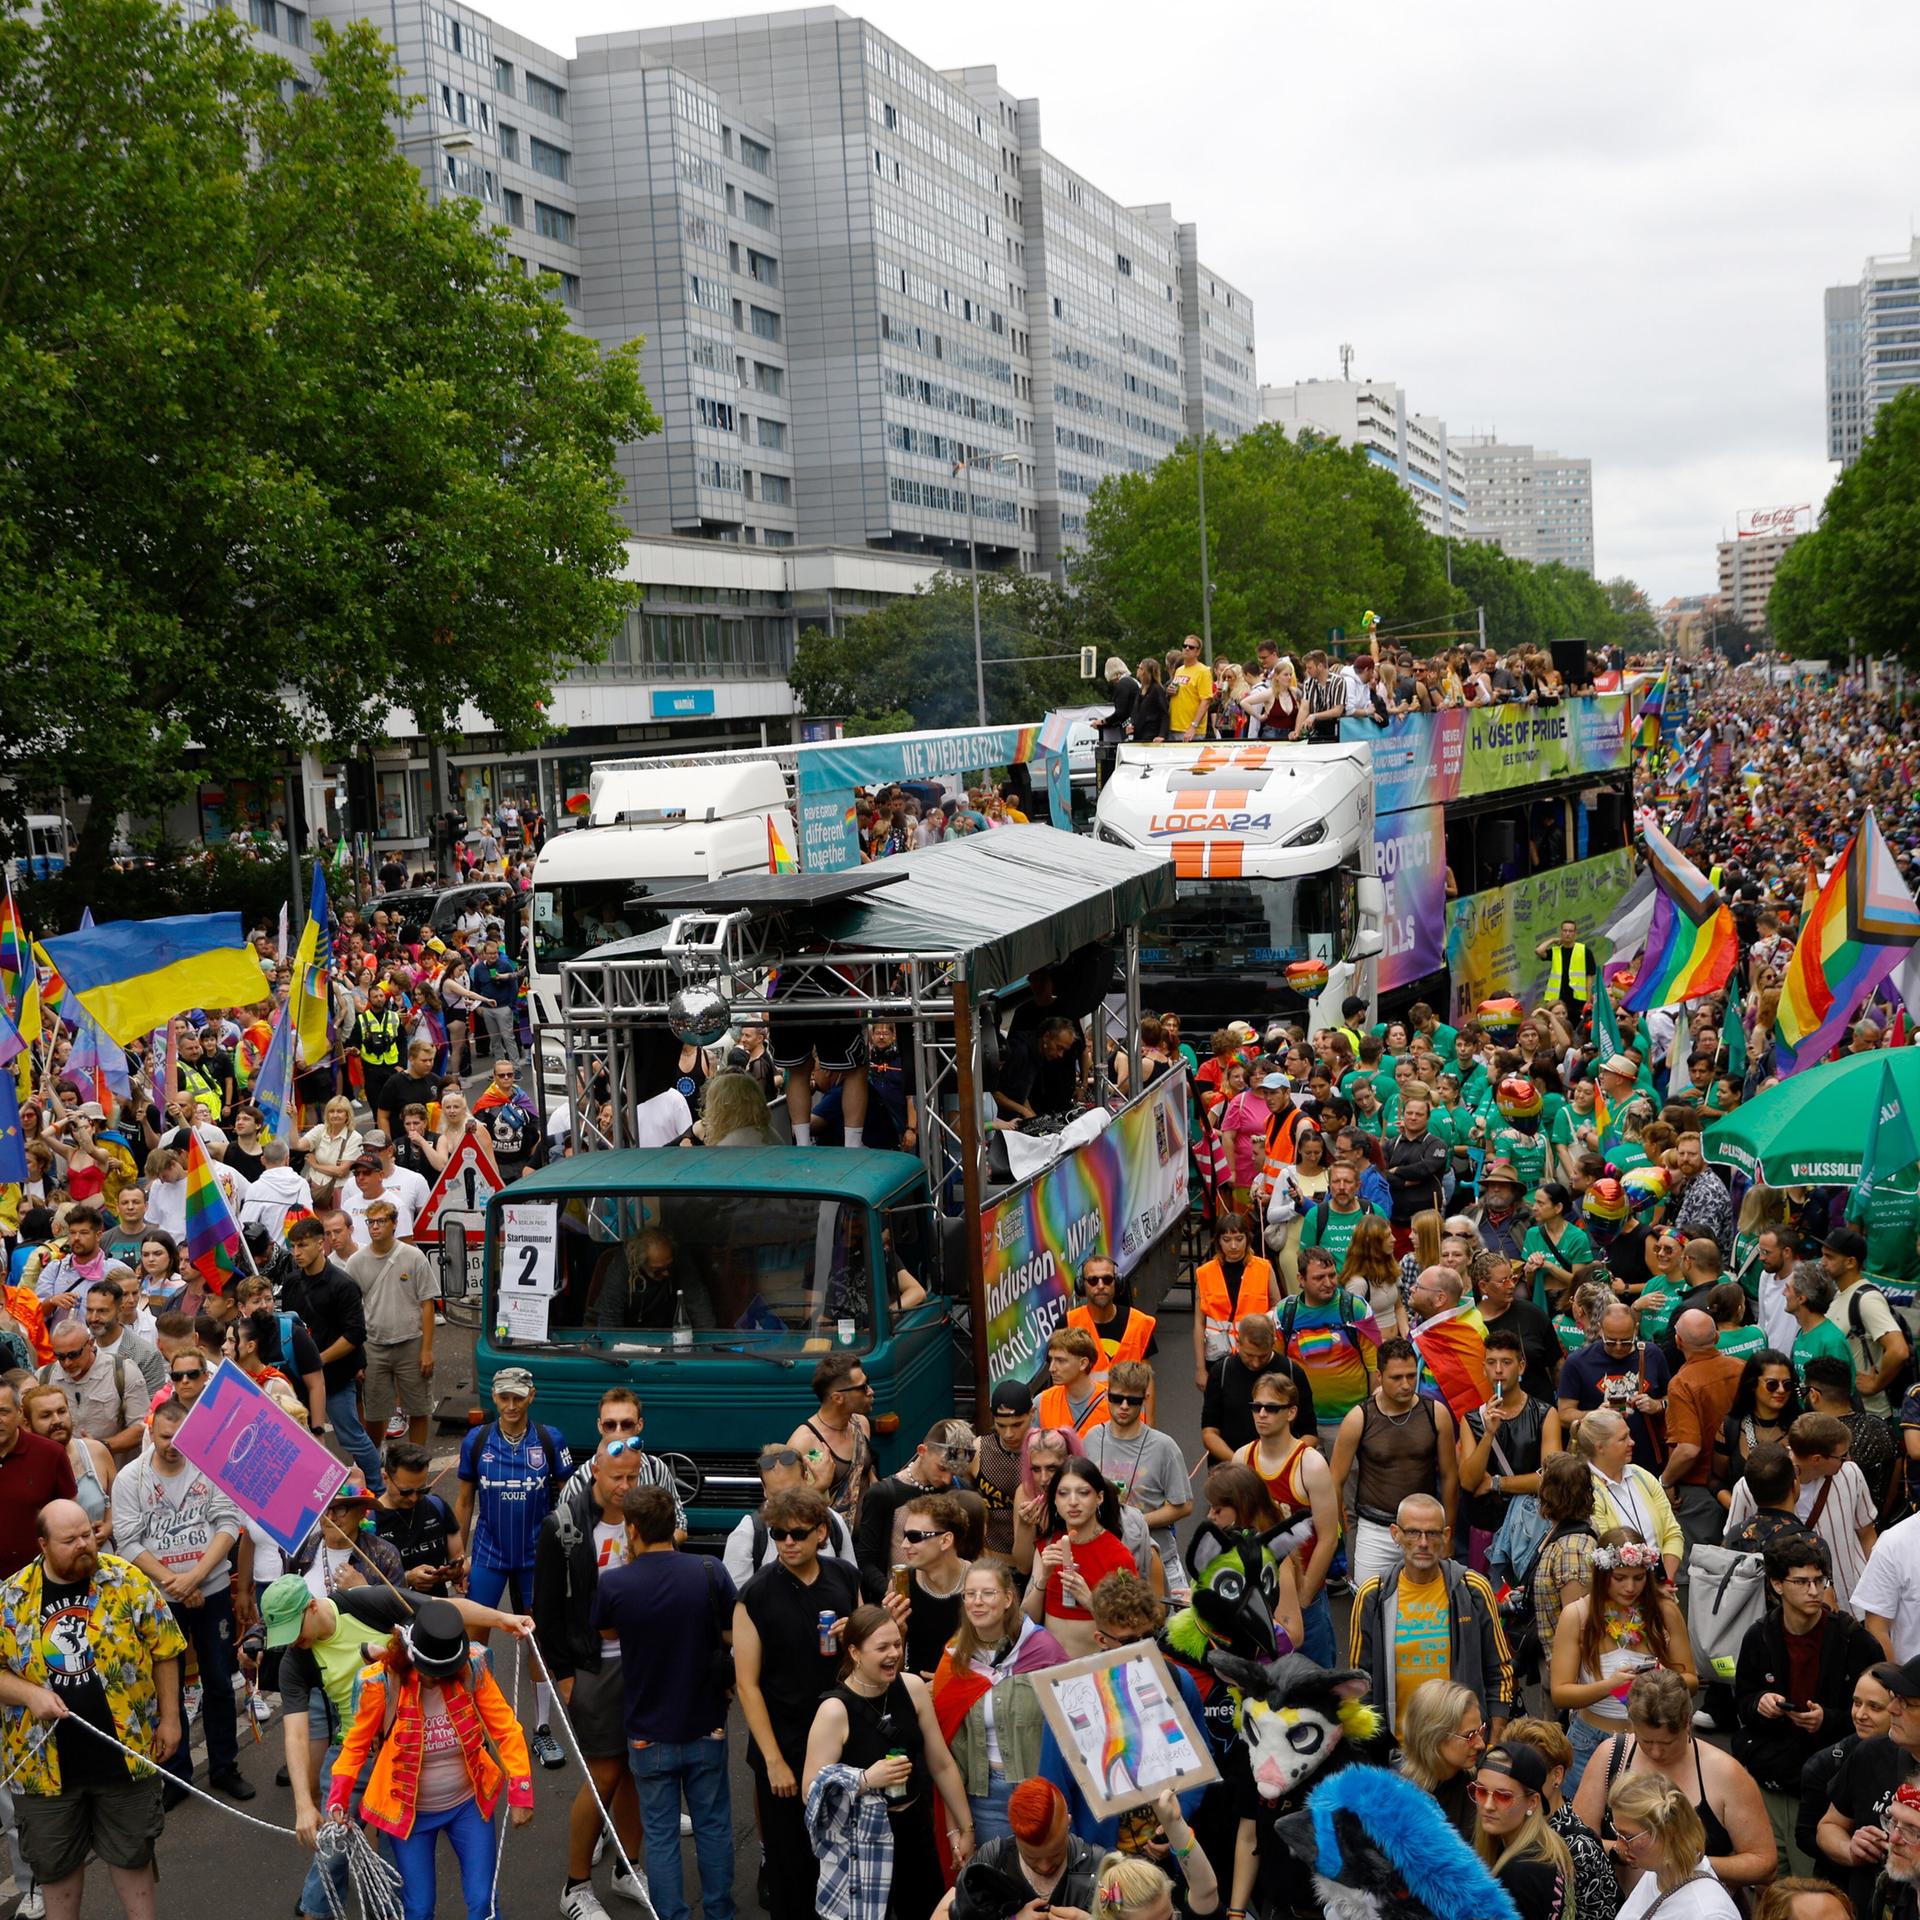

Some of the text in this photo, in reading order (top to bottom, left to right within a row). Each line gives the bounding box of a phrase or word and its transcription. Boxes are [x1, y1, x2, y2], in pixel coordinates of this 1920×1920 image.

[1442, 728, 1460, 742] NEVER
[1515, 721, 1530, 744] OF
[1532, 717, 1568, 742] PRIDE
[902, 735, 1003, 776] NIE WIEDER STILL!
[1442, 744, 1462, 759] SILENT
[819, 804, 838, 818] GROUP
[805, 823, 845, 844] different
[807, 845, 846, 869] together
[1374, 831, 1432, 877] ROTECT
[540, 906, 546, 917] 3
[1316, 943, 1328, 961] 4
[506, 1233, 553, 1244] Startnummer
[517, 1244, 539, 1286] 2
[986, 1250, 1056, 1322] Inklusion
[989, 1325, 1033, 1383] nicht
[501, 1491, 527, 1501] TOUR
[45, 1597, 70, 1614] WIR
[55, 1674, 70, 1686] DU
[1204, 1704, 1235, 1717] ames
[434, 1728, 456, 1739] The
